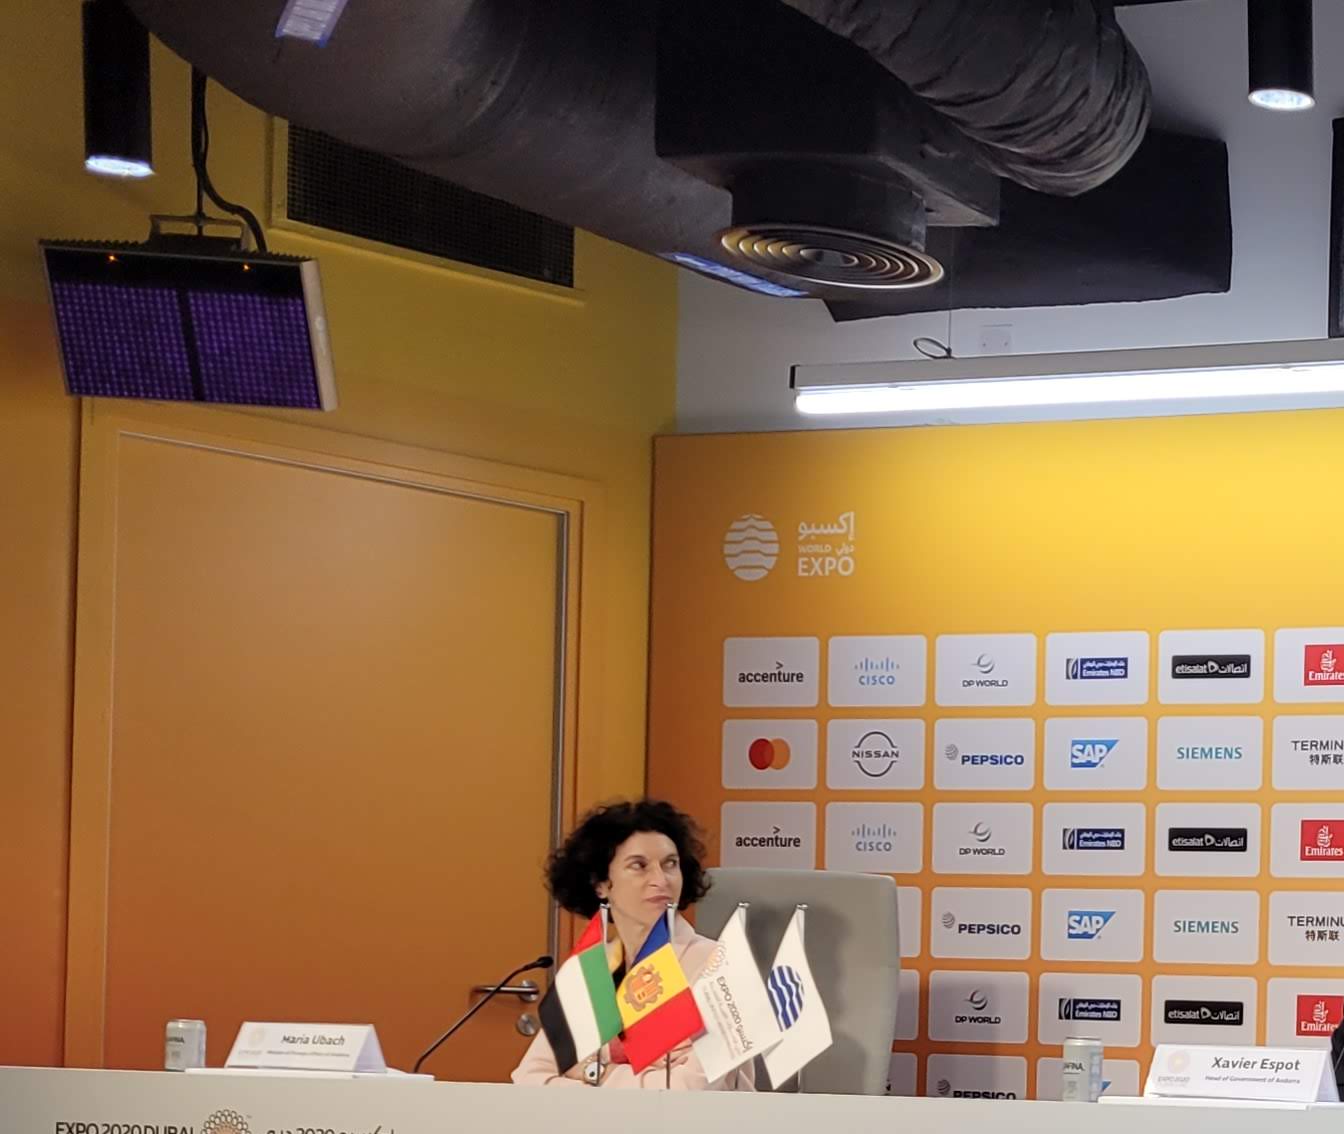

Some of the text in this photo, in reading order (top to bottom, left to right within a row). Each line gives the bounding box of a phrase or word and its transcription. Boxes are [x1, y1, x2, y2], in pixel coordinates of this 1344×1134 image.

[800, 511, 855, 541] إكسبو
[799, 556, 854, 576] EXPO
[738, 671, 803, 682] accenture
[859, 676, 895, 685] CISCO
[1071, 743, 1106, 765] SAP
[1178, 747, 1242, 759] SIEMENS
[962, 755, 1024, 765] PEPSICO
[736, 836, 800, 847] accenture
[856, 842, 892, 851] CISCO
[1305, 846, 1343, 858] Emirates
[958, 924, 1020, 934] PEPSICO
[1068, 915, 1103, 936] SAP
[1174, 921, 1238, 933] SIEMENS
[1212, 1057, 1300, 1073] Xavier Espot
